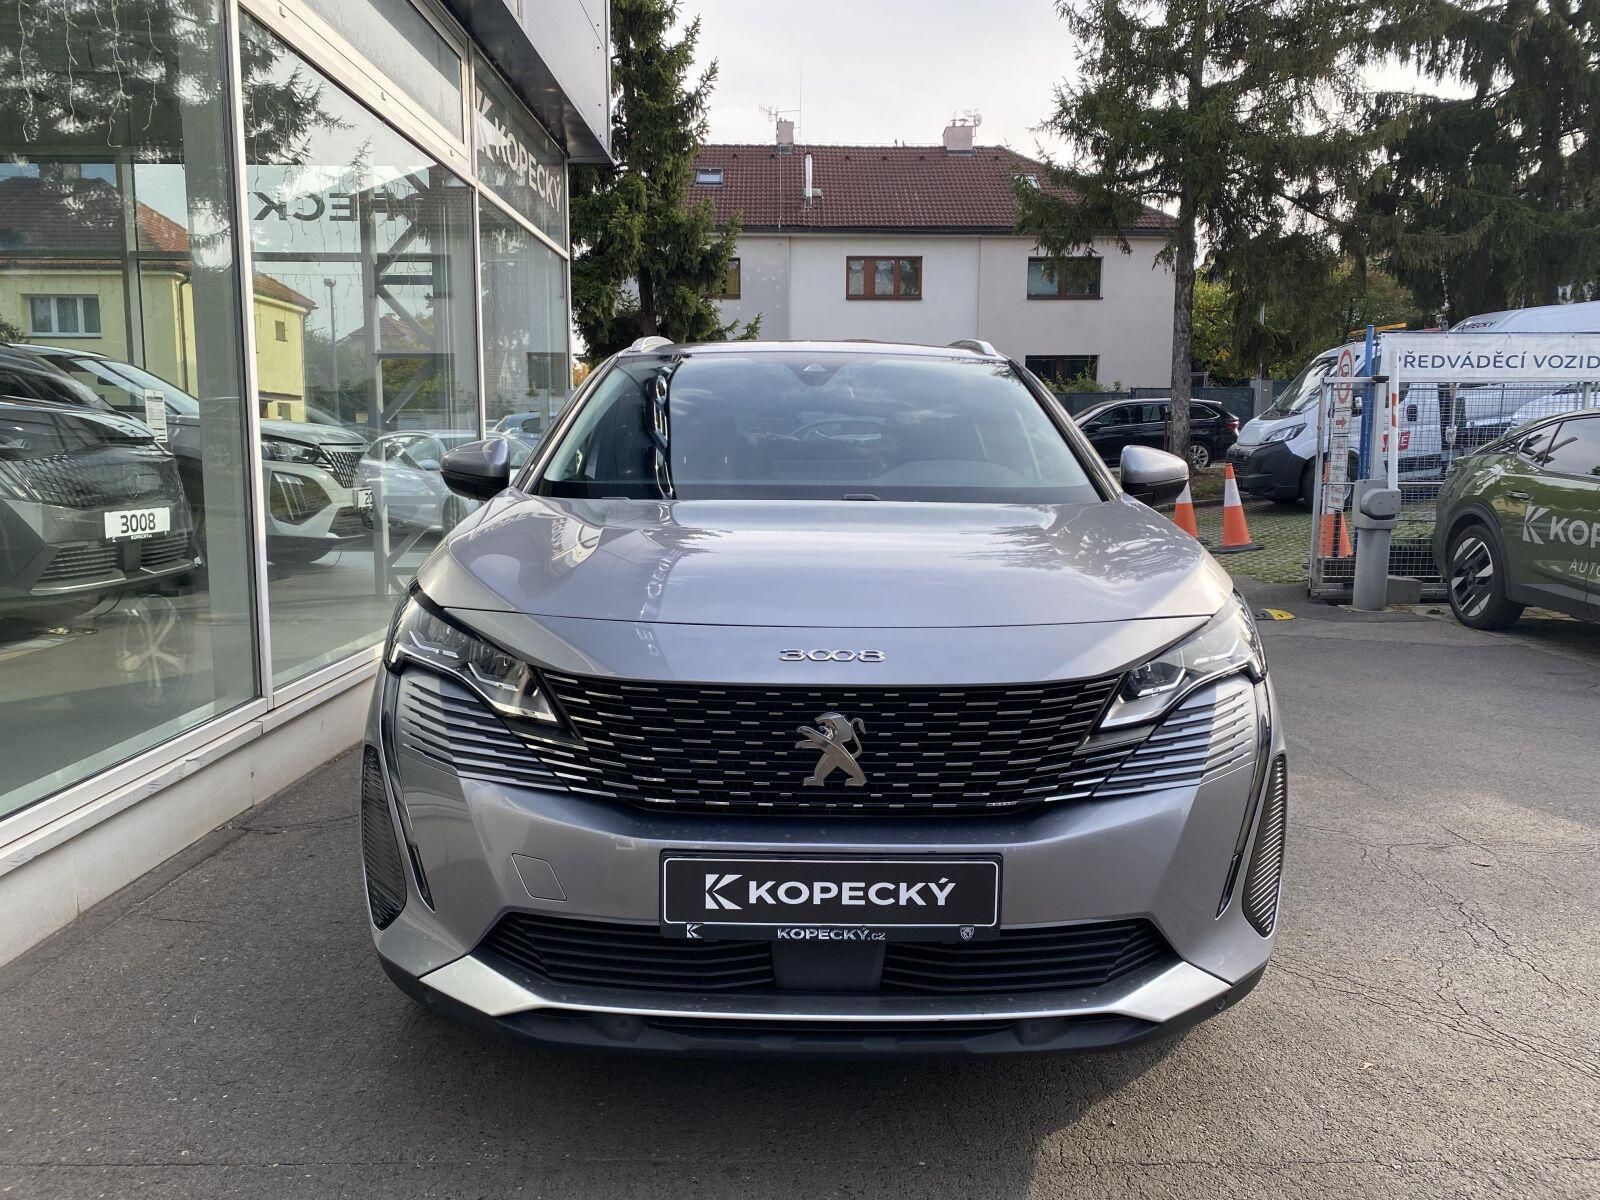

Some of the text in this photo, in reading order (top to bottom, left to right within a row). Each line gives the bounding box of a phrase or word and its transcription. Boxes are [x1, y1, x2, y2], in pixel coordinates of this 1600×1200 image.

[1399, 351, 1527, 369] ŘEDVÁDĚCÍ
[120, 512, 156, 534] 3008
[779, 648, 887, 662] 3008
[748, 877, 956, 906] KOPECKÝ
